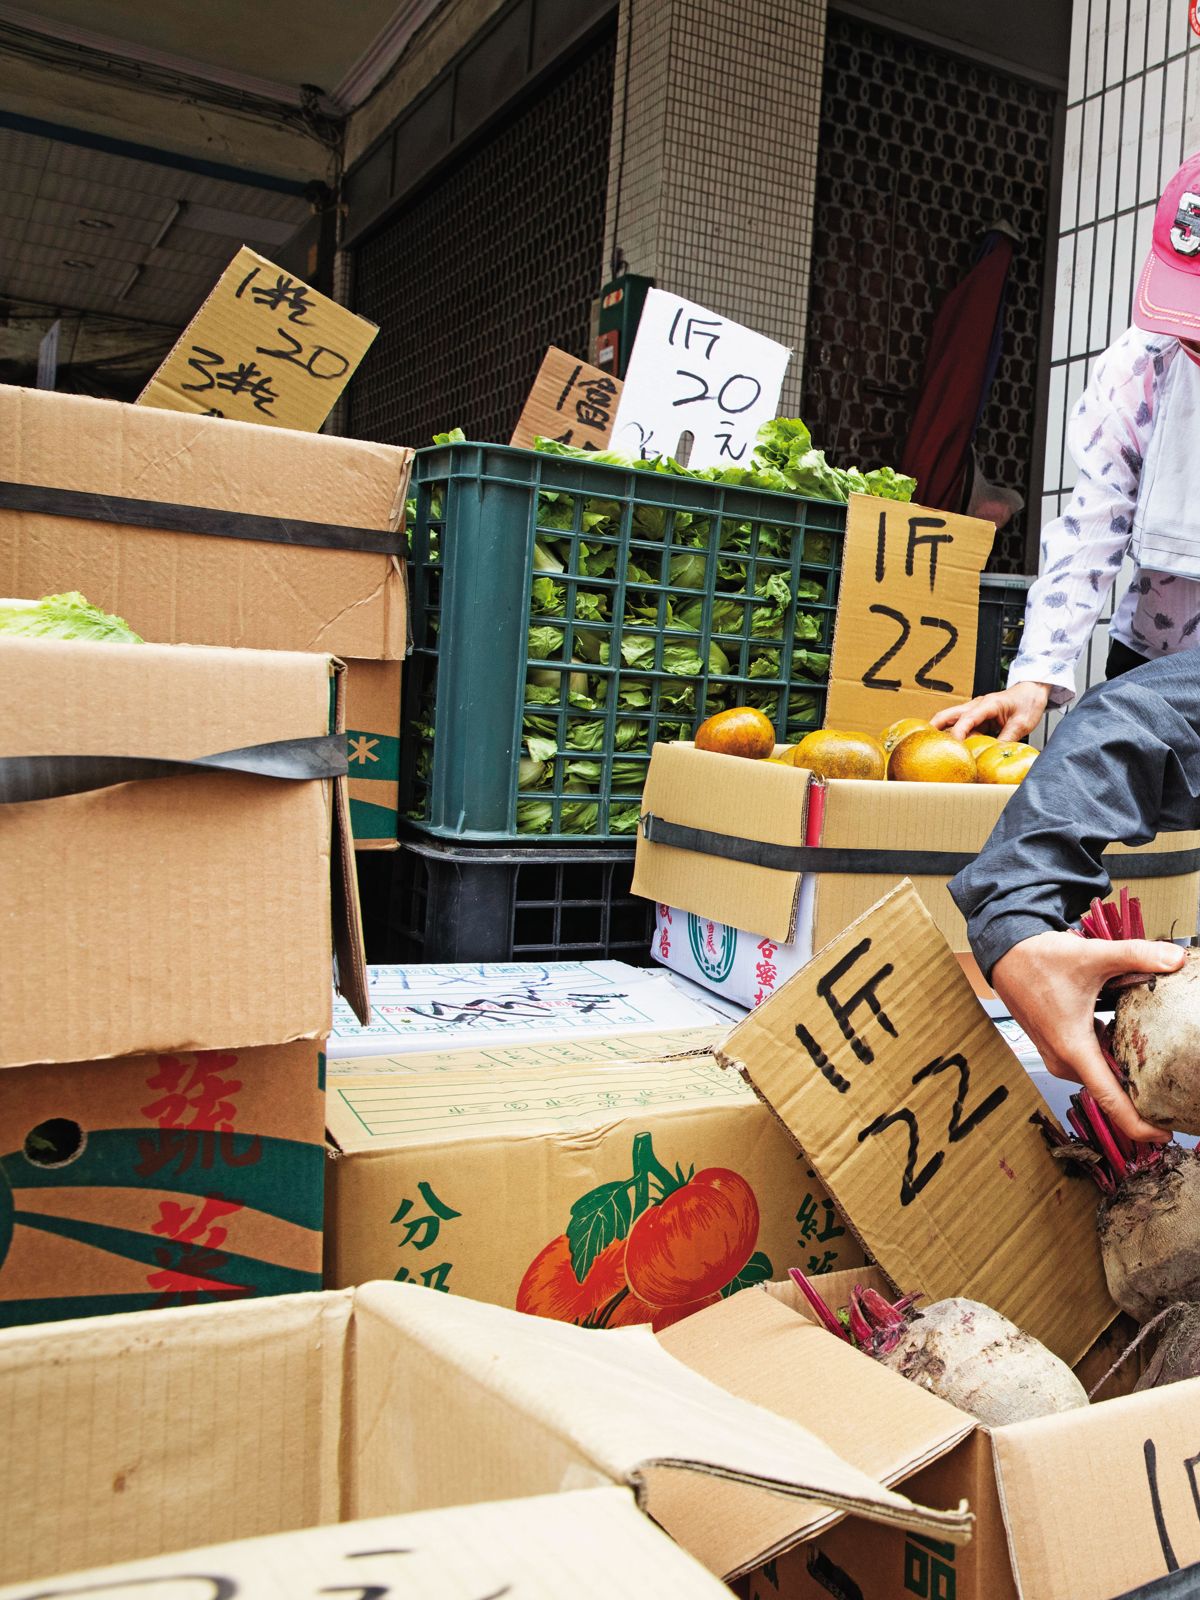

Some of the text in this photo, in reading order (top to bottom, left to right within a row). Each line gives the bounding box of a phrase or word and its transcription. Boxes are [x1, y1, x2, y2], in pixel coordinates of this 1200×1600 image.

[256, 327, 350, 380] 20
[668, 307, 722, 359] 1斤
[673, 369, 762, 414] 20
[874, 511, 954, 594] 1斤
[861, 604, 959, 693] 22
[795, 937, 894, 1094] 1斤
[857, 1053, 1010, 1207] 22
[132, 1052, 264, 1312] 蔬菜
